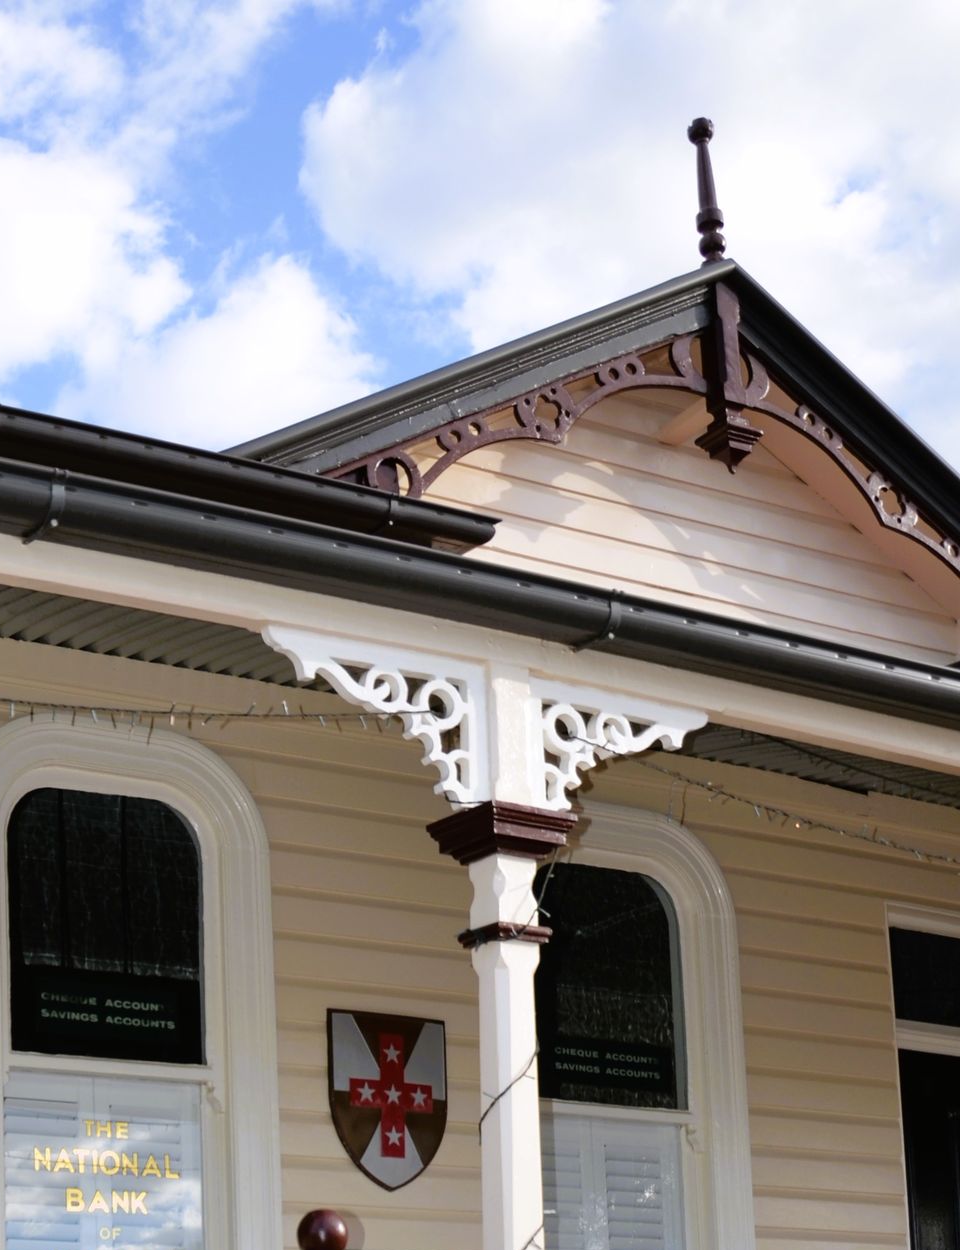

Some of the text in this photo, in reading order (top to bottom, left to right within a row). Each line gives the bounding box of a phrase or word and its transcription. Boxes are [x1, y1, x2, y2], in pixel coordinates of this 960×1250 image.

[41, 1008, 176, 1030] SAVINGS ACCOUNTS
[554, 1047, 599, 1059] CHEQUE
[555, 1062, 661, 1080] SAVINGS ACCOUNTS
[82, 1119, 129, 1140] THE
[32, 1147, 181, 1180] NATIONAL
[64, 1187, 149, 1215] BANK
[99, 1227, 122, 1241] OF
